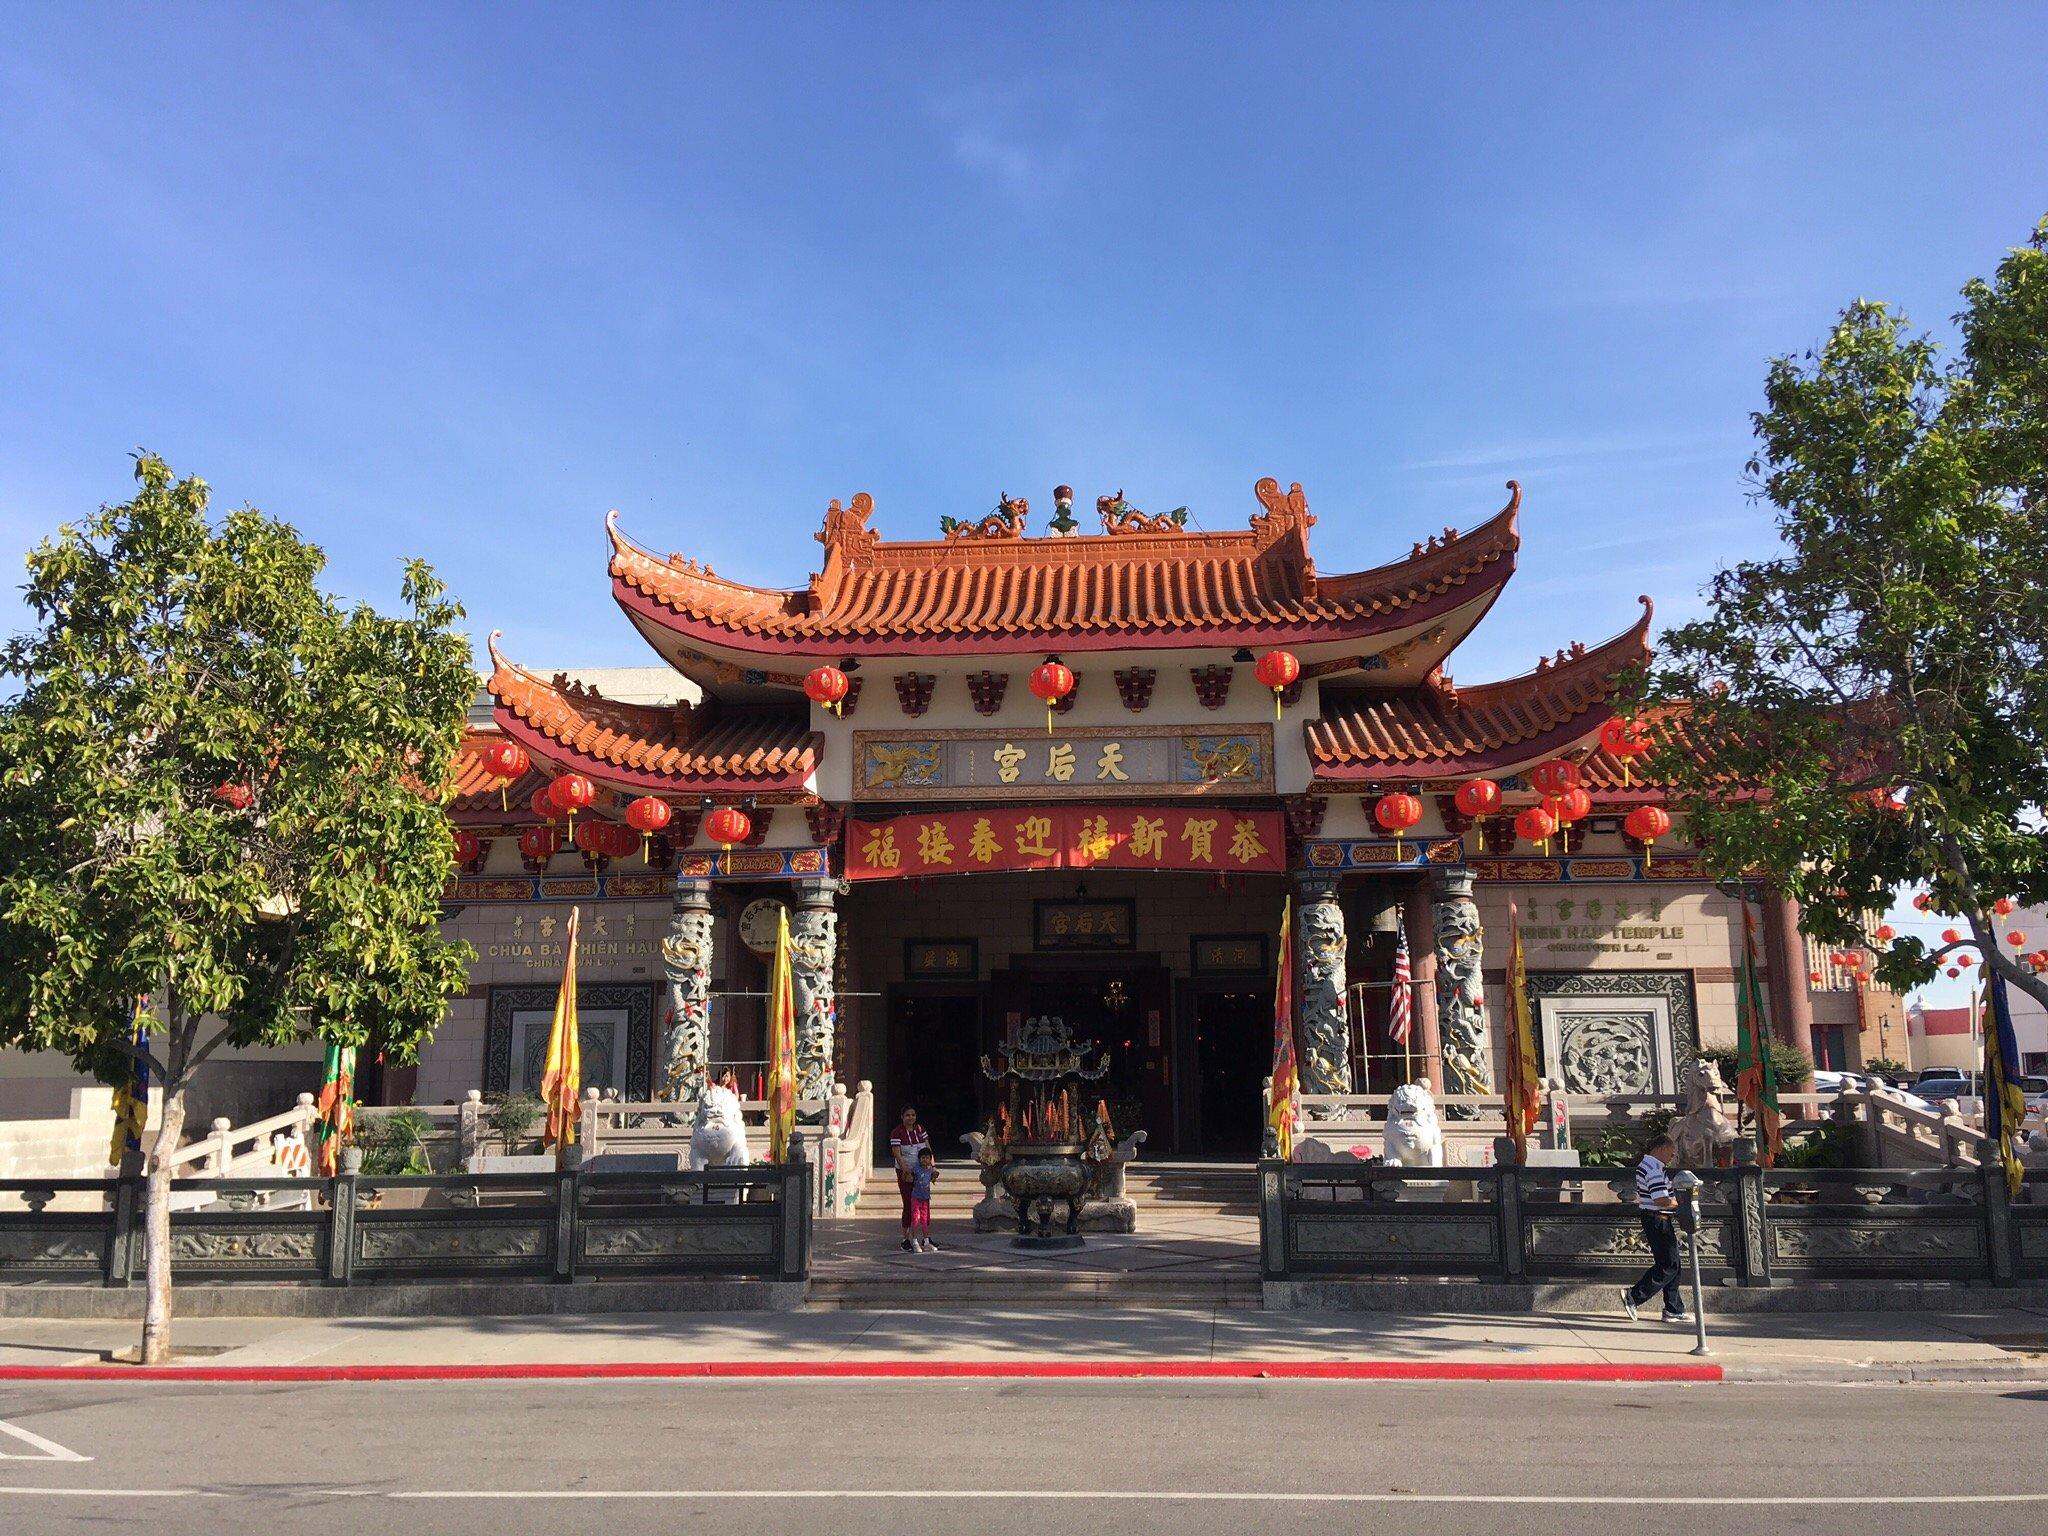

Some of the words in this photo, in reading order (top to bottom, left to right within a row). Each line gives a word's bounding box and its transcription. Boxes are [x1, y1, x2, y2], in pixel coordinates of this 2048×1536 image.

[993, 742, 1130, 783] 天后宮
[1611, 926, 1684, 939] TEMPLE
[576, 940, 618, 955] HIÊN
